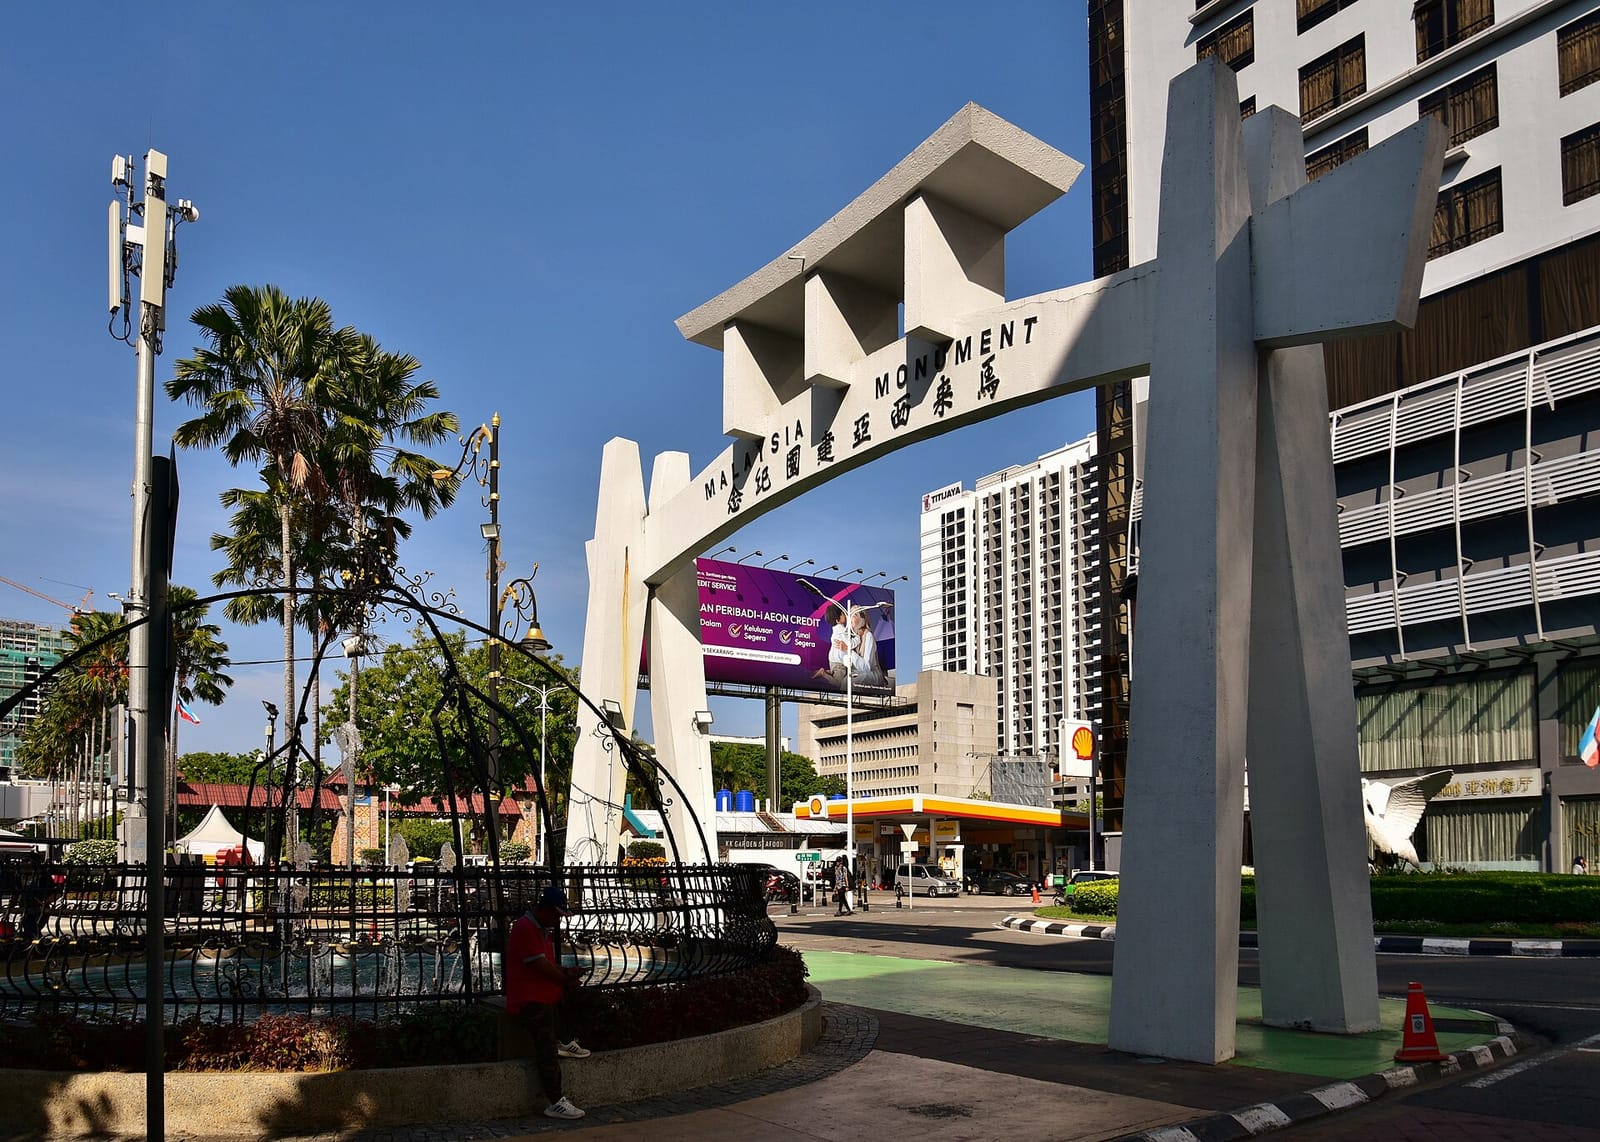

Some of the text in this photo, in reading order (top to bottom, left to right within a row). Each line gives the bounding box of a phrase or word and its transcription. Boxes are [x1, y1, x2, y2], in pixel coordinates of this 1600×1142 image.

[704, 316, 1039, 501] MALAYSIA MONUMENT
[931, 487, 960, 503] TITIJAYA
[711, 581, 737, 592] SERVICE
[699, 618, 722, 628] Dalam
[764, 613, 789, 624] AEON
[790, 615, 821, 628] CREDIT
[744, 624, 774, 635] Kelulusan
[794, 630, 811, 639] Tunai
[744, 633, 767, 643] Segera
[794, 640, 816, 649] Segera
[706, 648, 735, 656] SEKARANG
[1464, 776, 1534, 797] 亚洲餐厅
[734, 840, 758, 848] GARDEN
